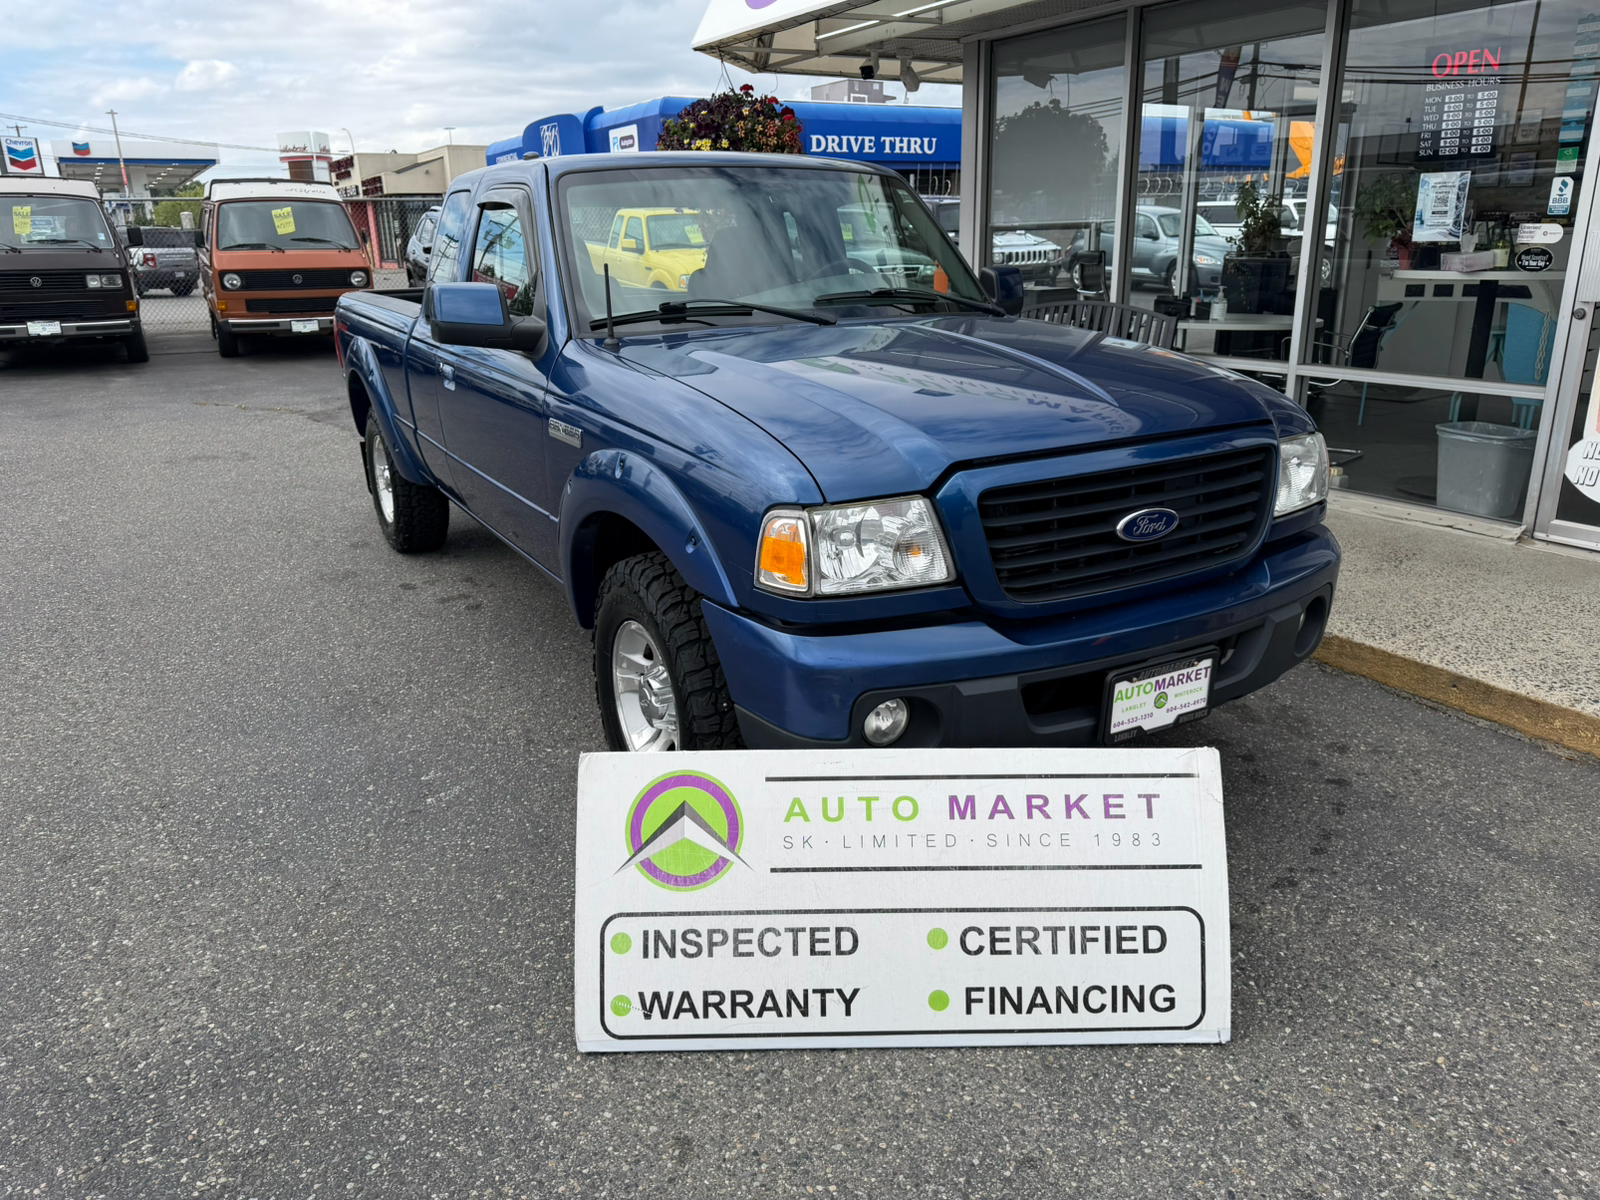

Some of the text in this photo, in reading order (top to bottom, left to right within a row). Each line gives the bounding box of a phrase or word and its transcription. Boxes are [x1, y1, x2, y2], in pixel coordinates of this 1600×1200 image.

[1432, 47, 1502, 78] OPEN
[1426, 76, 1501, 92] BUSINESS HOURS
[1424, 105, 1437, 113] TUE
[1425, 96, 1442, 104] MON
[5, 138, 33, 146] Chevron
[810, 134, 937, 154] DRIVE THRU
[1133, 513, 1167, 536] Ford
[1114, 666, 1211, 703] AUTOMARKET
[1121, 702, 1147, 713] LANGLEY
[1166, 697, 1207, 714] 604-542-4970
[1112, 712, 1154, 729] 604-533-1310
[783, 794, 1161, 823] AUTO MARKET
[783, 832, 1162, 850] SK LIMITED SINCE 1983
[642, 926, 859, 959] INSPECTED
[958, 925, 1168, 957] CERTIFIED
[638, 987, 861, 1021] WARRANTY
[964, 983, 1177, 1016] FINANCING
